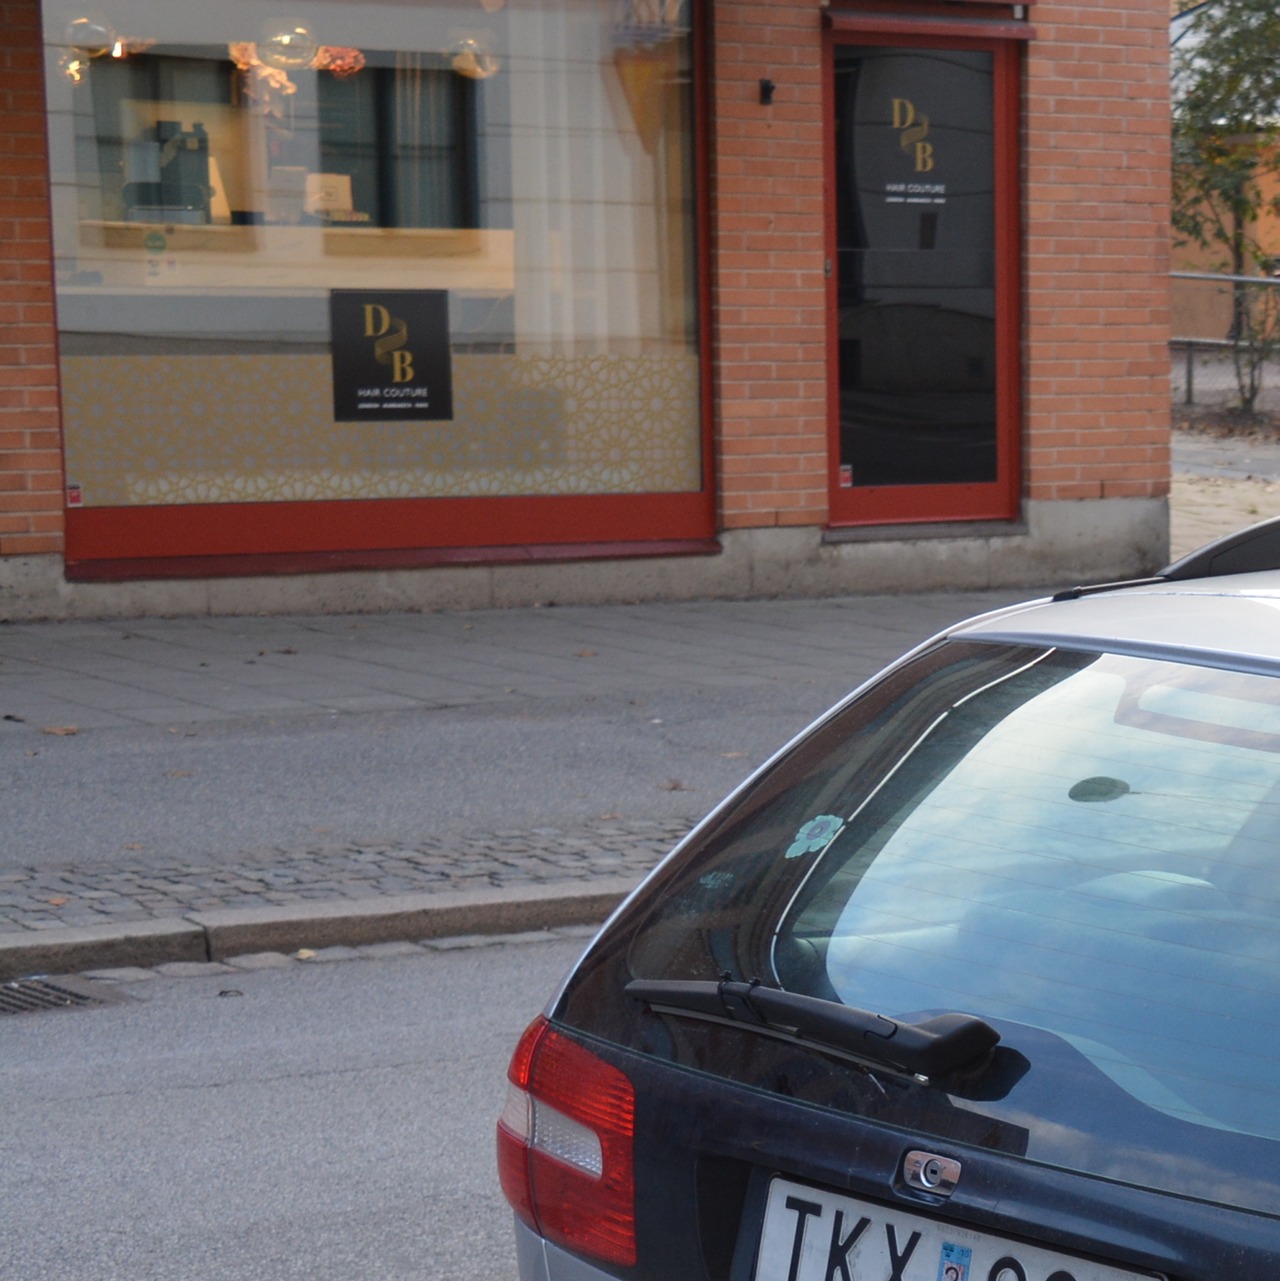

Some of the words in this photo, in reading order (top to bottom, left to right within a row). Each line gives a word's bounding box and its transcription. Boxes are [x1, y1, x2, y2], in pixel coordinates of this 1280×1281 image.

[363, 304, 391, 336] D
[392, 350, 415, 383] B
[357, 387, 380, 397] HAIR
[382, 387, 428, 397] COUTURE
